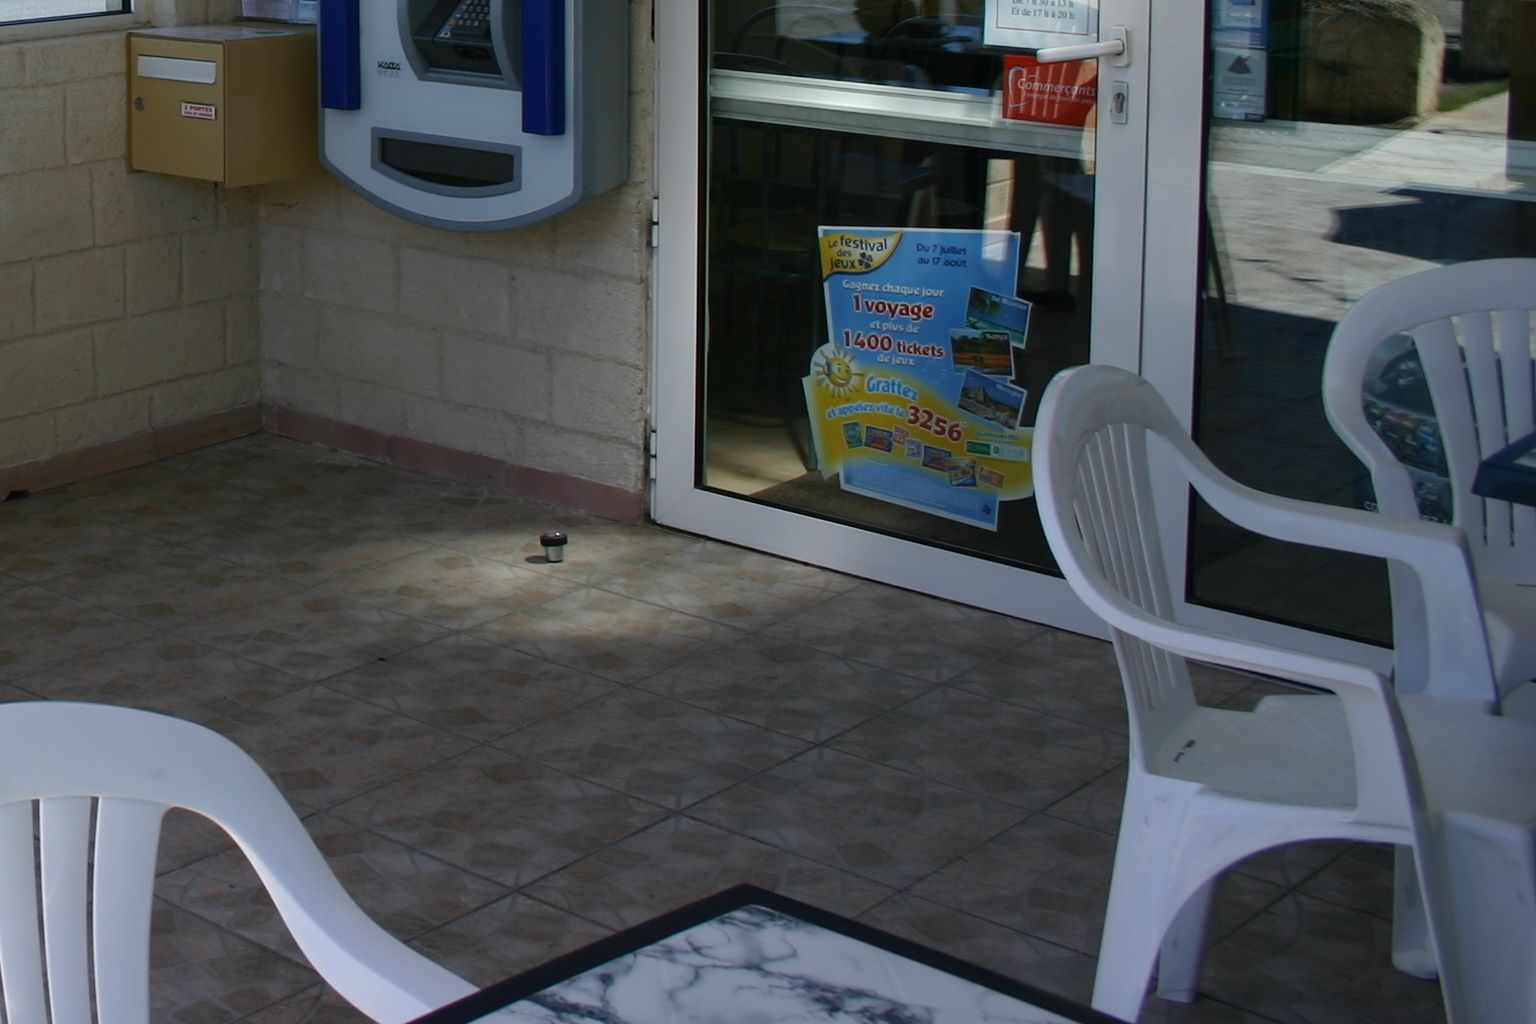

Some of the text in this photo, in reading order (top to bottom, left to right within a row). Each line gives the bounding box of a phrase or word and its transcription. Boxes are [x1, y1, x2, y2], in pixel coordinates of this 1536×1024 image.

[1068, 0, 1074, 8] h
[1011, 7, 1019, 16] Et
[1021, 8, 1031, 16] de
[1033, 8, 1042, 17] 17
[1043, 8, 1049, 18] h
[1057, 10, 1068, 19] 20
[1068, 11, 1075, 20] h
[828, 235, 888, 252] Le festival
[916, 243, 929, 253] Du
[932, 244, 938, 253] 7
[836, 249, 852, 257] des
[917, 257, 929, 265] au
[932, 257, 941, 266] 17
[842, 279, 945, 299] Gagnez chaque jour
[853, 293, 935, 322] 1 voyage
[870, 320, 920, 334] et plus de
[896, 340, 945, 359] tickets
[877, 354, 916, 367] de jeux
[865, 376, 919, 402] Grattez
[906, 404, 964, 443] 3256
